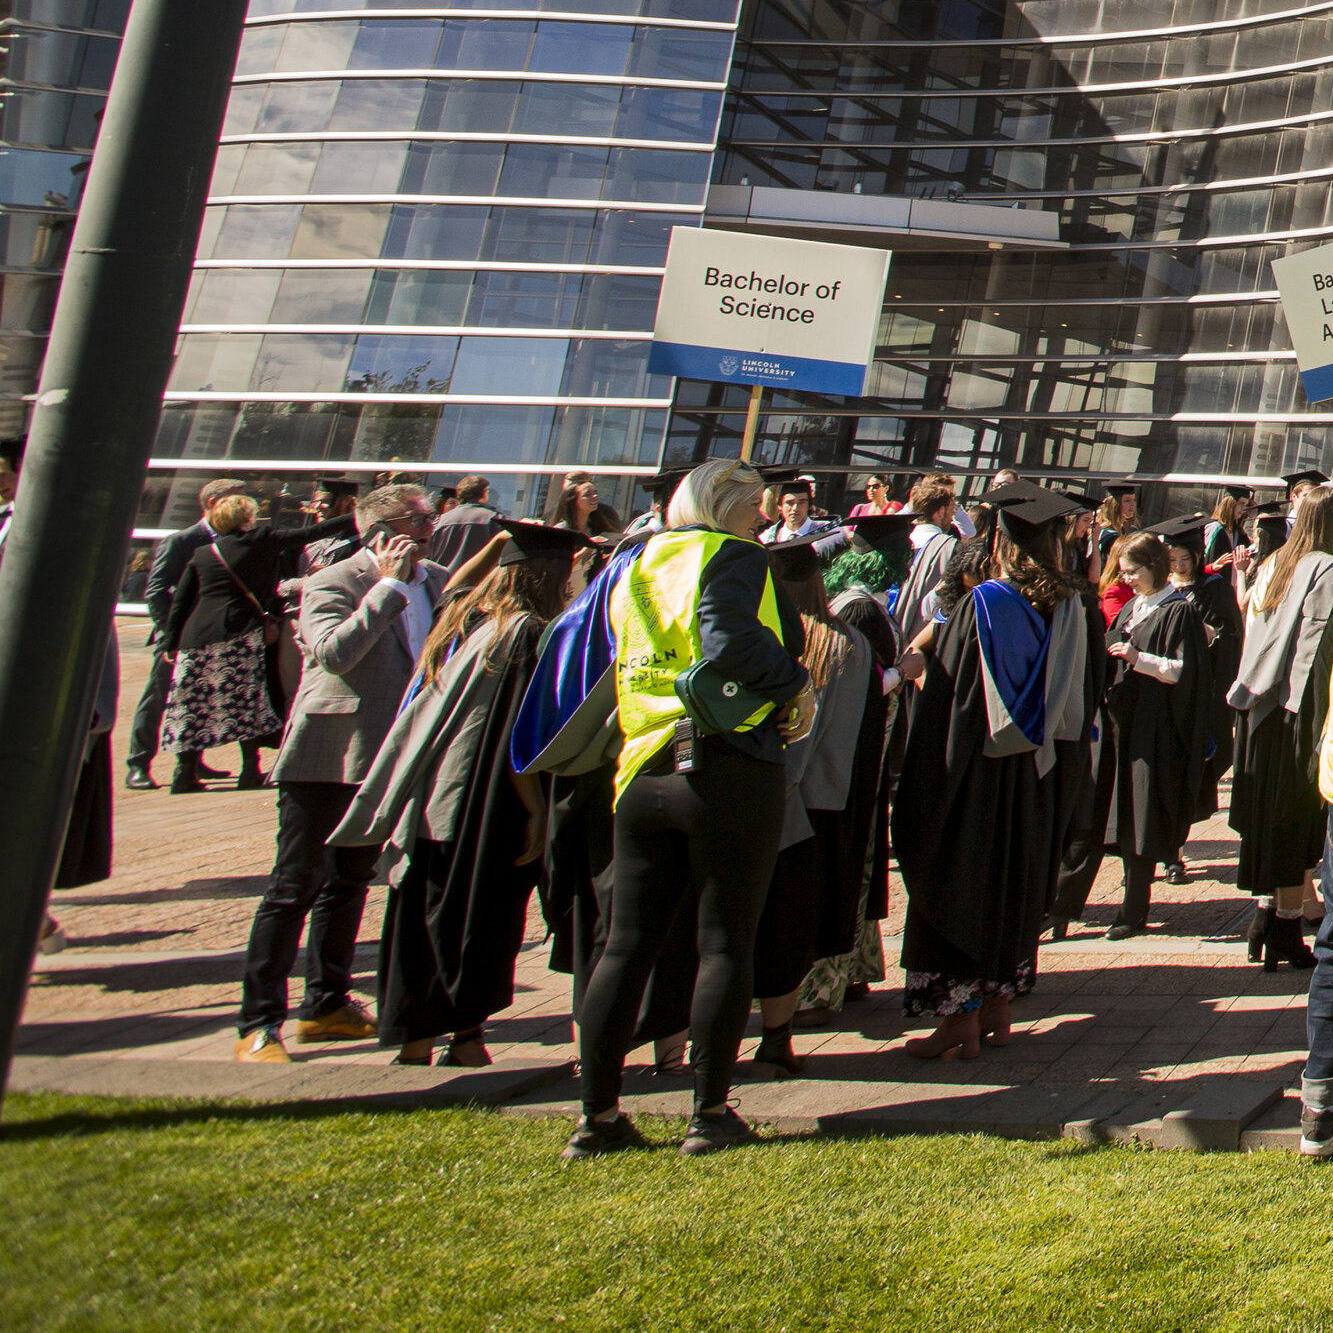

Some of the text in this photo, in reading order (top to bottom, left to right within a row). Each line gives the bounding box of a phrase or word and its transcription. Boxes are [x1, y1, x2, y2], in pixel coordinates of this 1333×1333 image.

[704, 266, 841, 301] Bachelor of
[719, 295, 815, 324] Science
[741, 365, 796, 376] UNIVERSITY
[742, 359, 780, 368] LINCOLN
[618, 648, 678, 673] NCOLN
